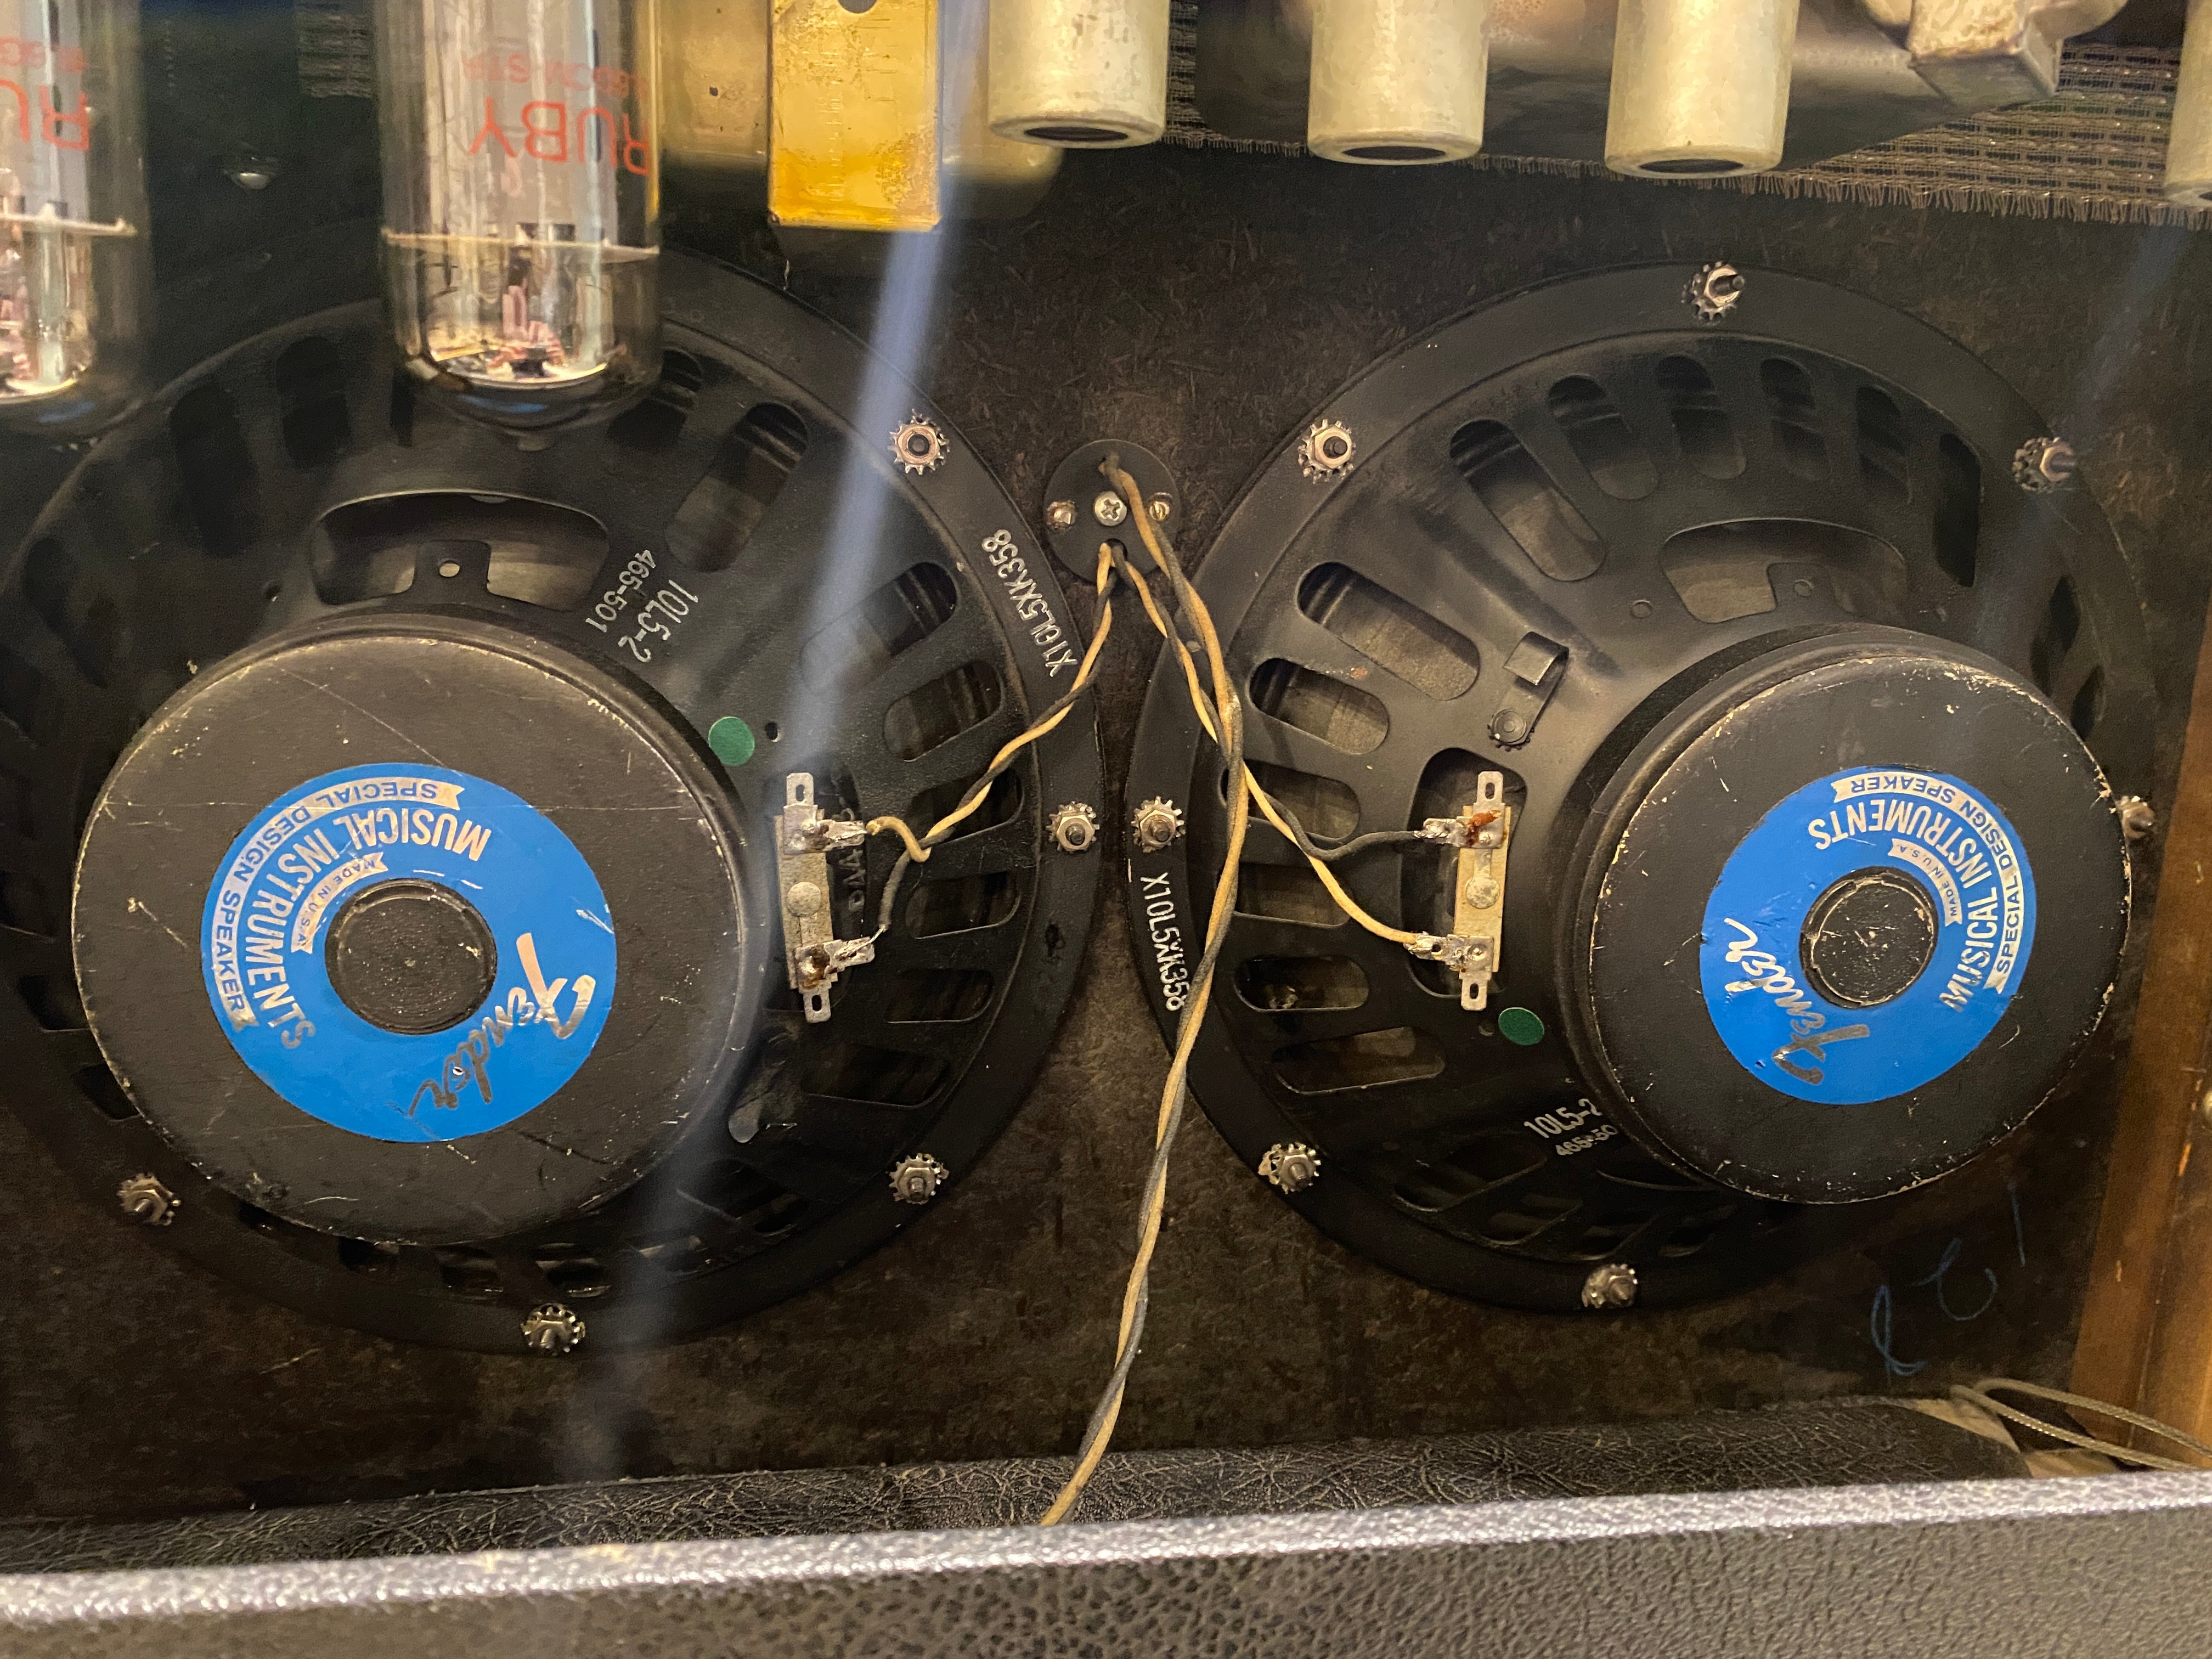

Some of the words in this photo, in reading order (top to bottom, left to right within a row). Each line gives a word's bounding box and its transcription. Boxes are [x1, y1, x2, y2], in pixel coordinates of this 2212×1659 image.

[468, 95, 650, 176] RUBY
[585, 550, 656, 633] 465-501
[618, 579, 698, 662] 10L5-2
[981, 529, 1078, 677] X10L5XK358
[316, 781, 438, 806] SPECIAL
[1850, 776, 1956, 804] SPEAKER
[234, 805, 311, 882] DESIGN
[333, 808, 492, 861] MUSICAL
[333, 860, 375, 885] MADE
[1808, 799, 1993, 889] INSTRUMENTS
[1932, 866, 1944, 878] IN
[1960, 800, 2013, 869] DESIGN
[317, 885, 331, 899] IN
[1942, 881, 1957, 916] MADE
[1996, 874, 2018, 974] SPECIAL
[216, 890, 245, 1012] SPEAKER
[245, 828, 340, 1048] INSTRUMENTS
[1140, 872, 1190, 1011] X10L5XK358
[1939, 887, 1997, 1012] MUSICAL
[408, 932, 596, 1116] Fender
[1724, 917, 1870, 1086] Fender
[1524, 1098, 1603, 1138] 10L5-2
